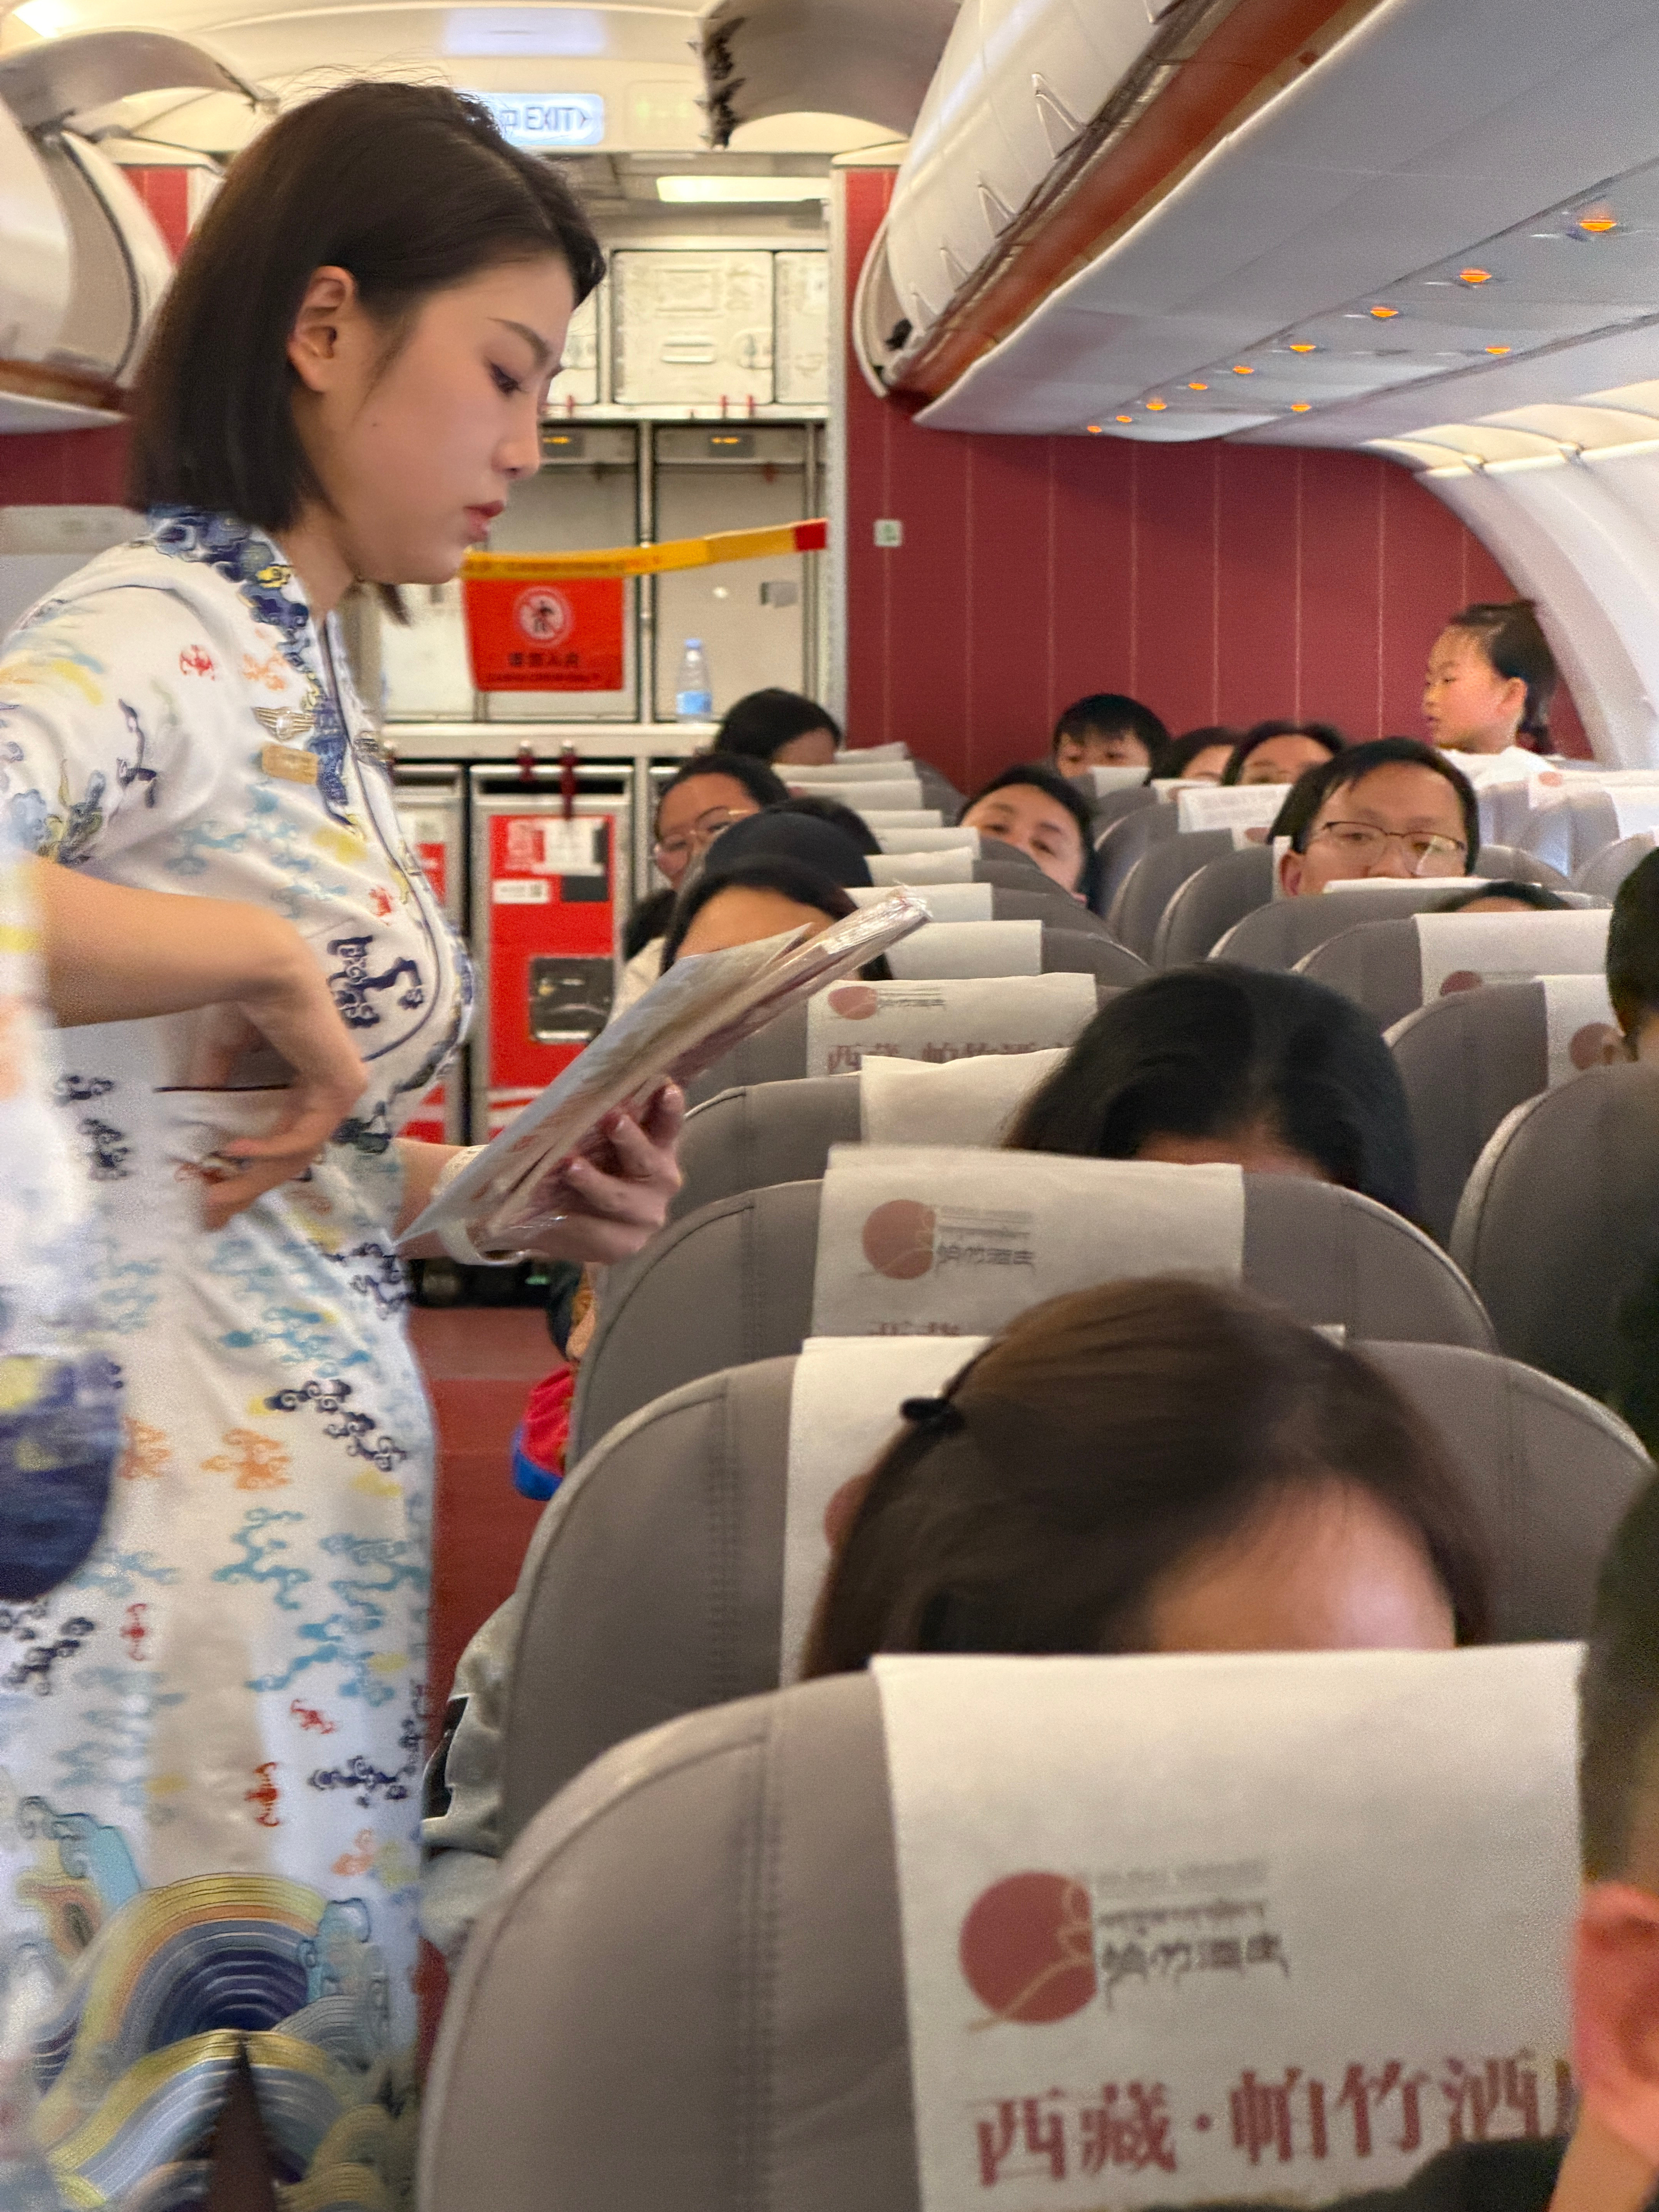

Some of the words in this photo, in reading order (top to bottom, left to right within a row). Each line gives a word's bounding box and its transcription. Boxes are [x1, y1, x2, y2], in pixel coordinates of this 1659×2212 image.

[524, 105, 579, 131] EXIT
[968, 2047, 1580, 2188] 西藏·帕竹酒
